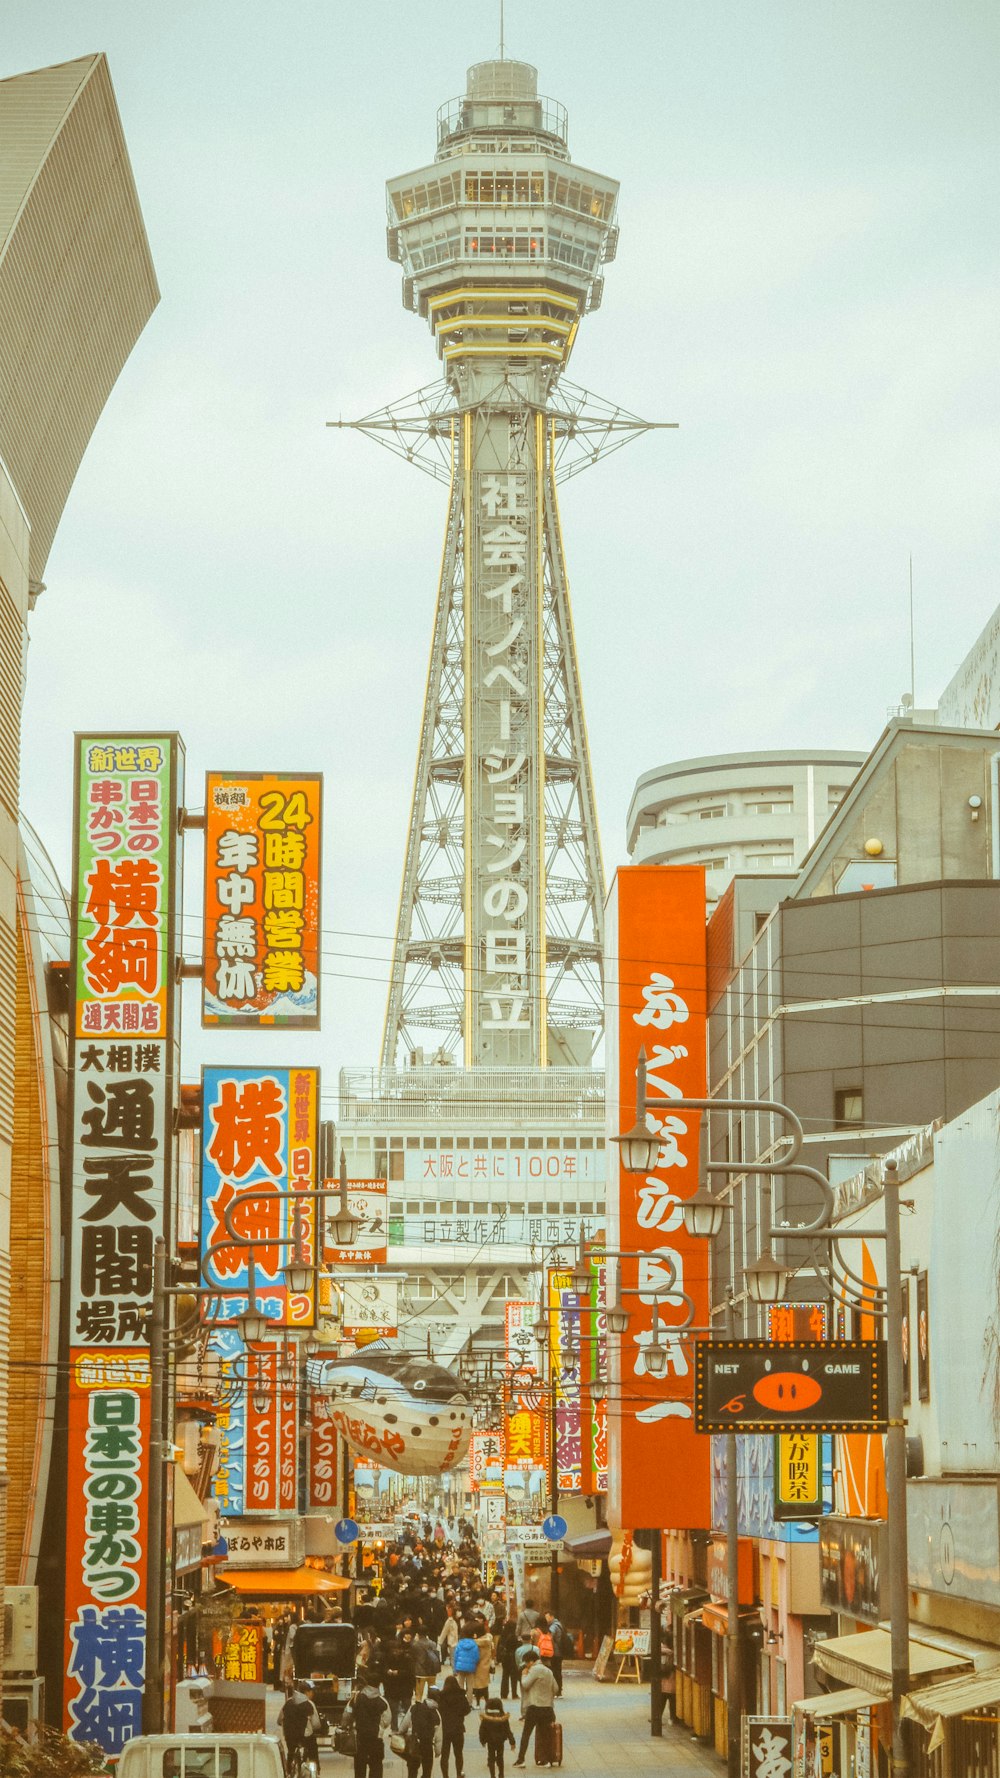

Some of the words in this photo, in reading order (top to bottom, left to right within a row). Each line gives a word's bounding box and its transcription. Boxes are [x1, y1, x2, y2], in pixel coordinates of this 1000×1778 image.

[89, 747, 163, 772] 新世界
[481, 474, 531, 1031] 社会イノベーションの日立
[216, 830, 259, 998] 年中無休
[259, 792, 312, 991] 24時間営業
[86, 858, 160, 995] 横綱
[84, 1003, 159, 1031] 通天閣店
[79, 1044, 162, 1073] 大相撲
[294, 1073, 311, 1142] 新世界
[78, 1078, 159, 1297] 通天閣
[208, 1080, 284, 1278] 横綱
[423, 1219, 506, 1243] 日立製作所
[75, 1301, 153, 1344] 場所
[714, 1364, 739, 1374] NET
[824, 1364, 860, 1374] GAME
[508, 1411, 532, 1460] 通天
[86, 1393, 138, 1597] 日本一の串かつ
[224, 1536, 286, 1552] ぼらや本店
[225, 1643, 240, 1682] 営業
[239, 1628, 259, 1681] 24時間
[70, 1607, 146, 1755] 横綱
